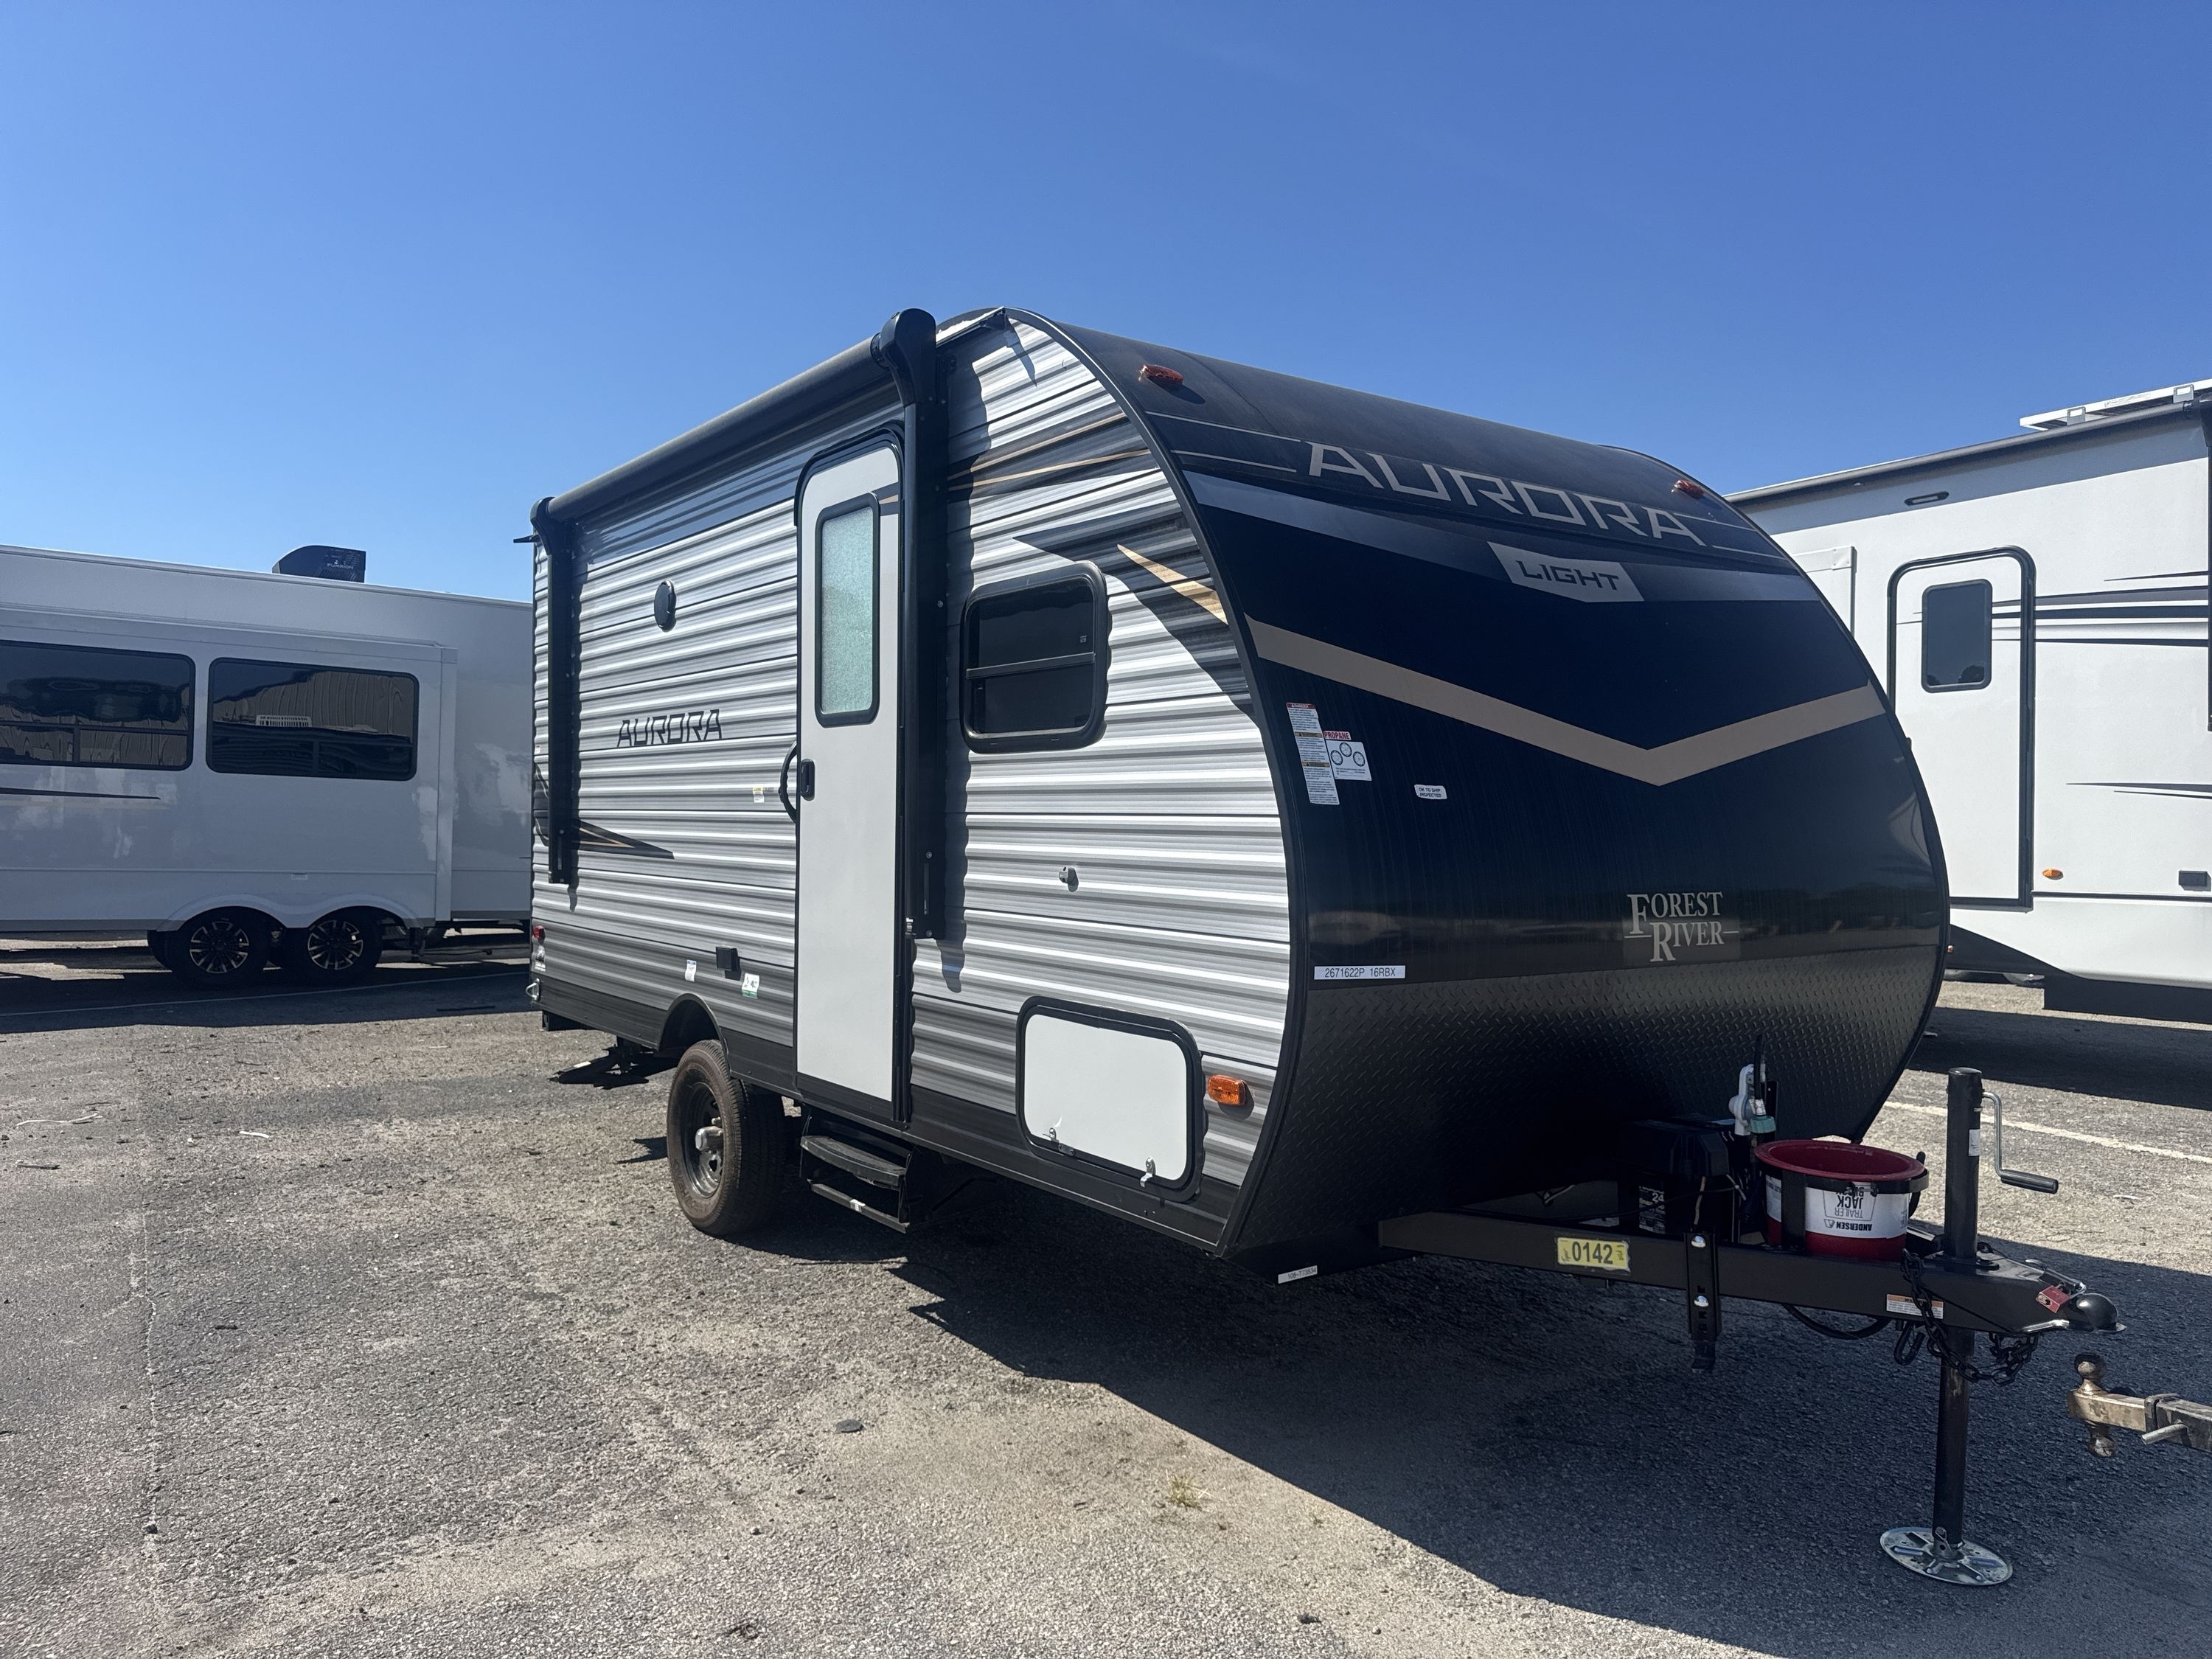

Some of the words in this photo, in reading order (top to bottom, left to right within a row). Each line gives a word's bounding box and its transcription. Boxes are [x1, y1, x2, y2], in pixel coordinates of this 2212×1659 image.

[1307, 441, 1706, 546] AURORA
[1516, 560, 1619, 591] LIGHT
[617, 709, 722, 747] AURORA
[1324, 731, 1350, 740] PROPANE
[1627, 891, 1724, 934] FOREST
[1649, 921, 1725, 962] RIVER
[1325, 967, 1365, 978] 2671622P
[1370, 967, 1396, 977] 16RBX
[1834, 1207, 1864, 1218] TRAILER
[1837, 1195, 1864, 1209] JACK
[1836, 1221, 1873, 1231] ANDERSEN
[1572, 1241, 1613, 1265] 0142
